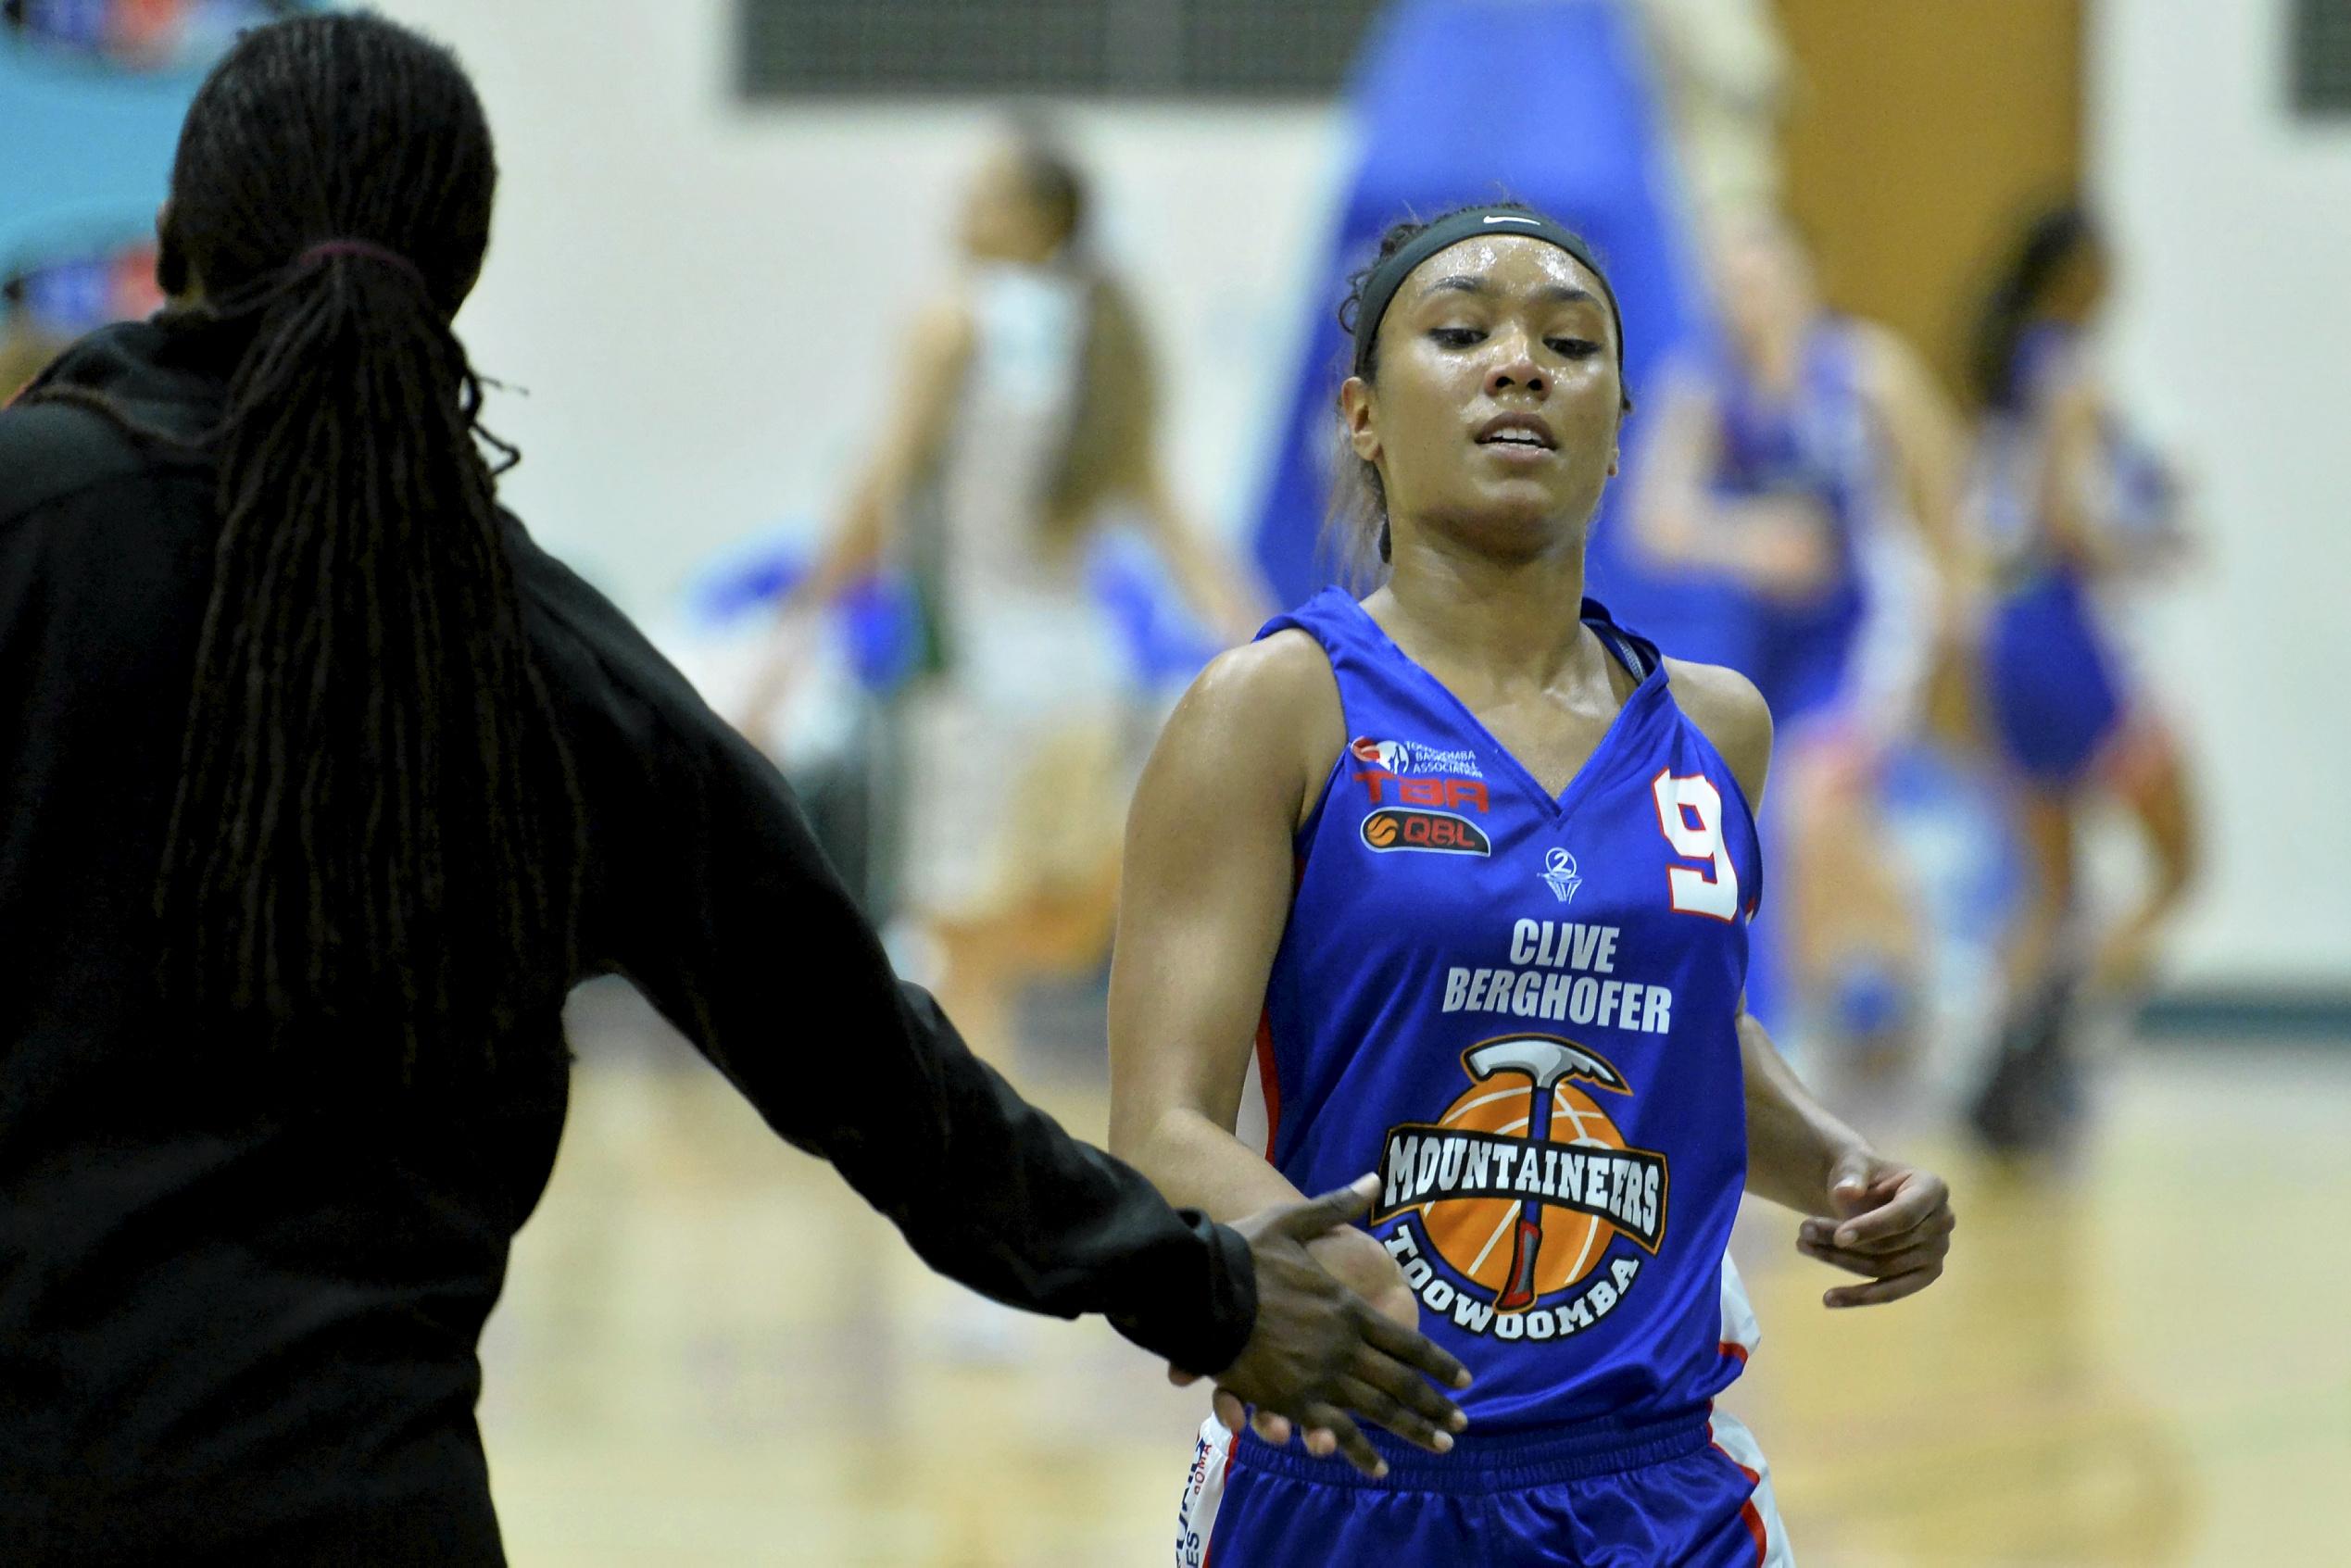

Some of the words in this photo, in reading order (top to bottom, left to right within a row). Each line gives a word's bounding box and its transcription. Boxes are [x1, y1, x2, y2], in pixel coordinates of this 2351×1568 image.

[1353, 770, 1490, 812] TBA
[1403, 816, 1476, 847] QBL
[1651, 765, 1739, 924] 9
[1510, 918, 1620, 973] CLIVE
[1442, 967, 1673, 1035] BERGHOFER
[1384, 1135, 1660, 1236] MOUNTAINEERS
[1385, 1224, 1640, 1340] TOOWOOMBA
